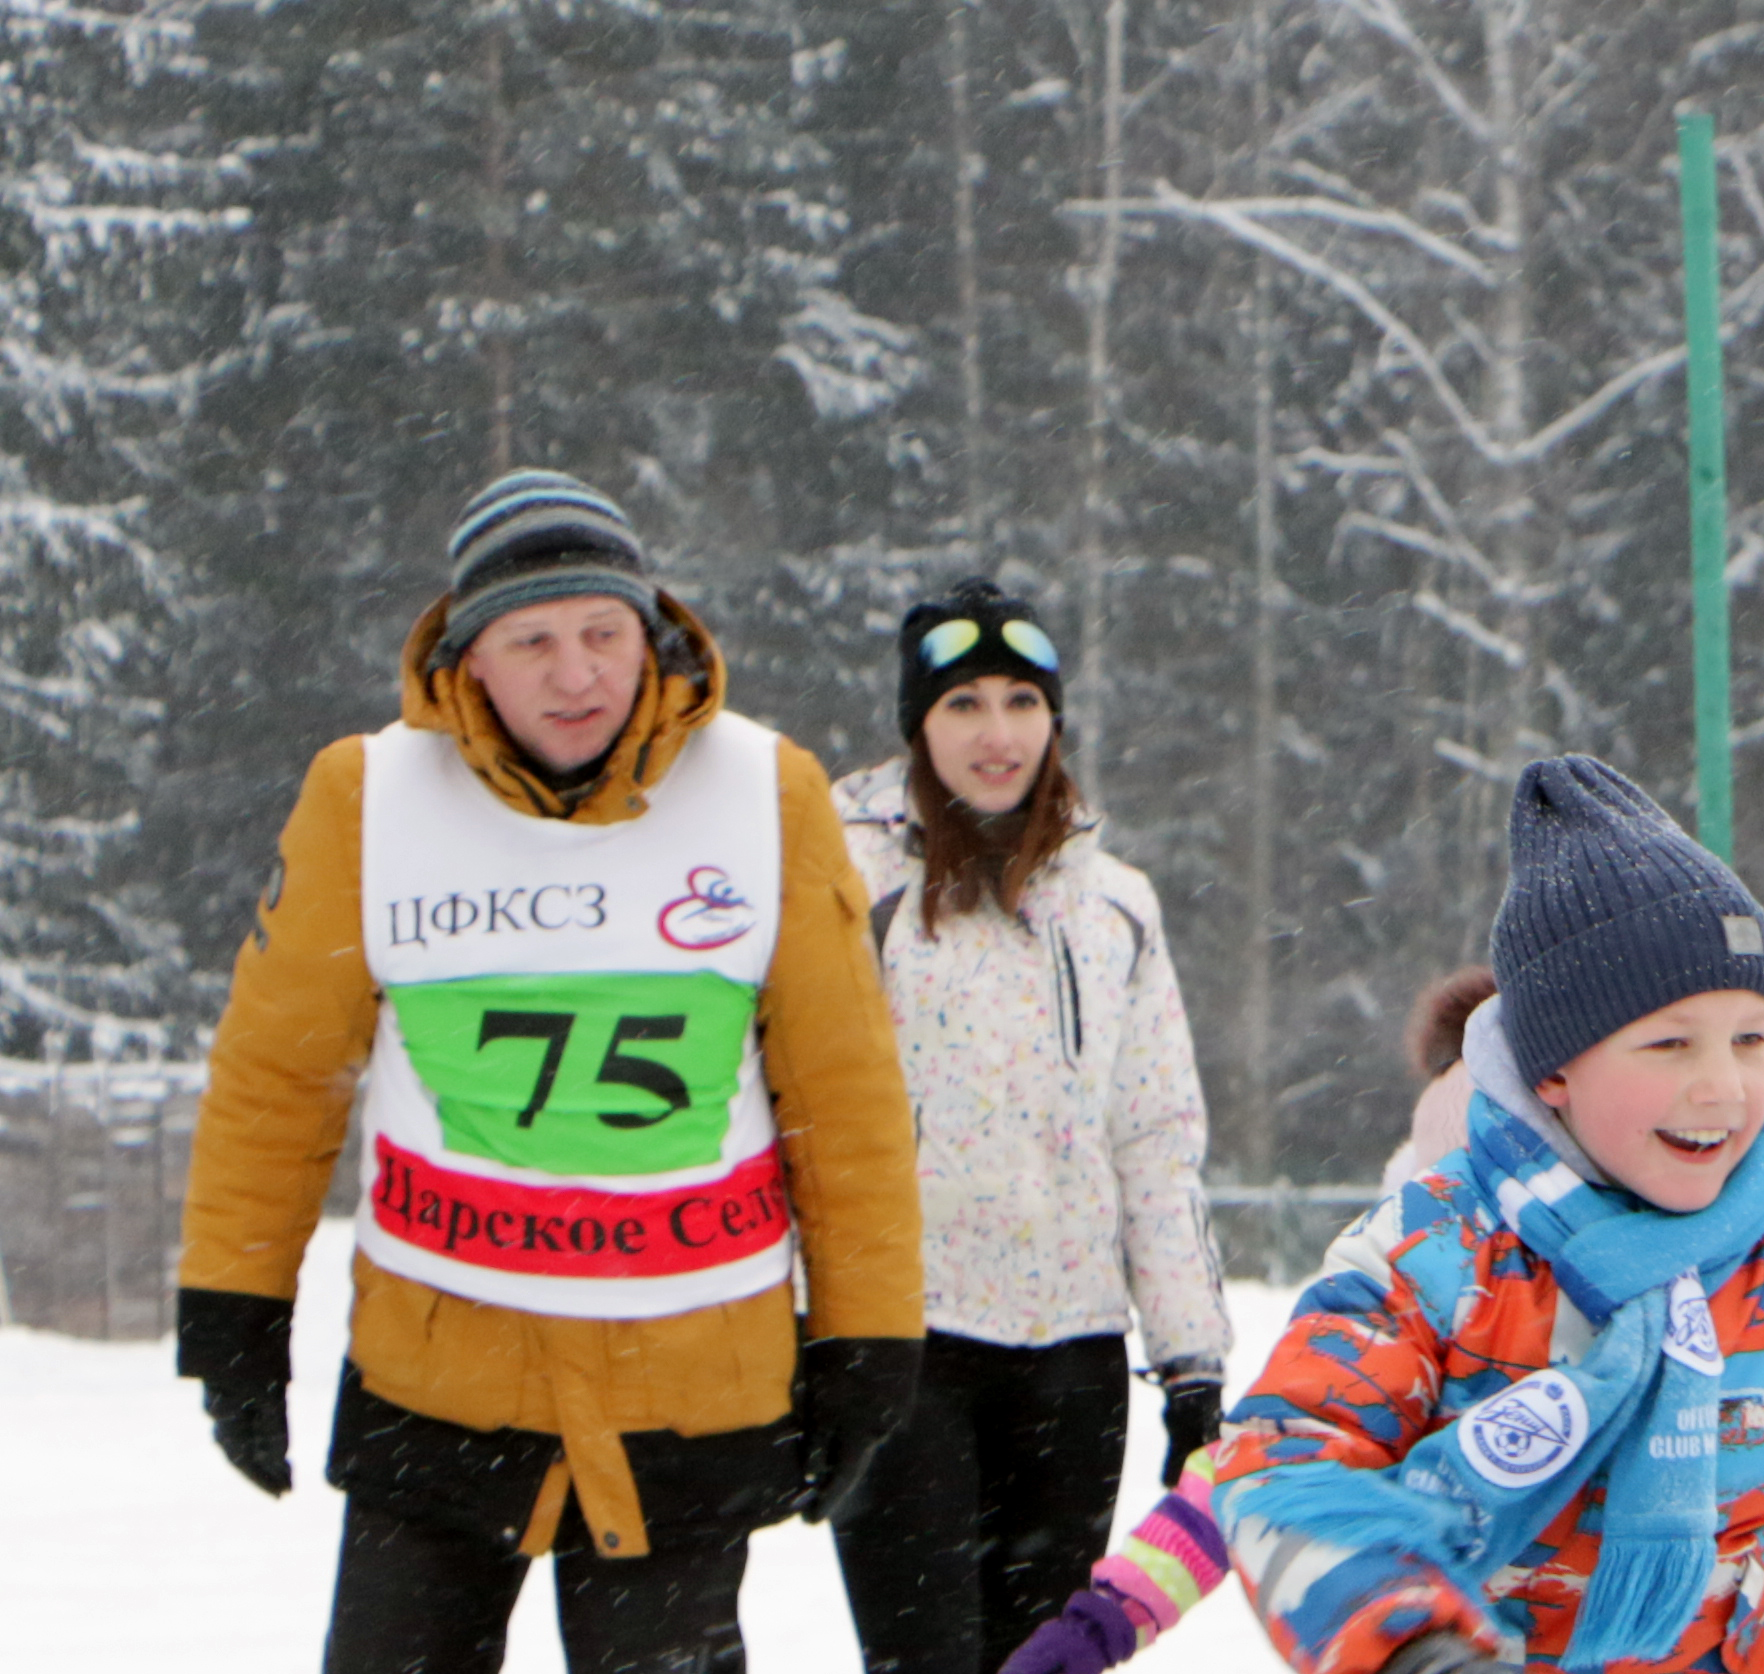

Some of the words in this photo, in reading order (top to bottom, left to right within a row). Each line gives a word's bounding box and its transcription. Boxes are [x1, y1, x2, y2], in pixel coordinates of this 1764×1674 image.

[388, 883, 609, 948] ЦФКСЗ
[476, 1010, 691, 1129] 75
[381, 1154, 646, 1256] Царское
[1650, 1435, 1701, 1459] CLUB
